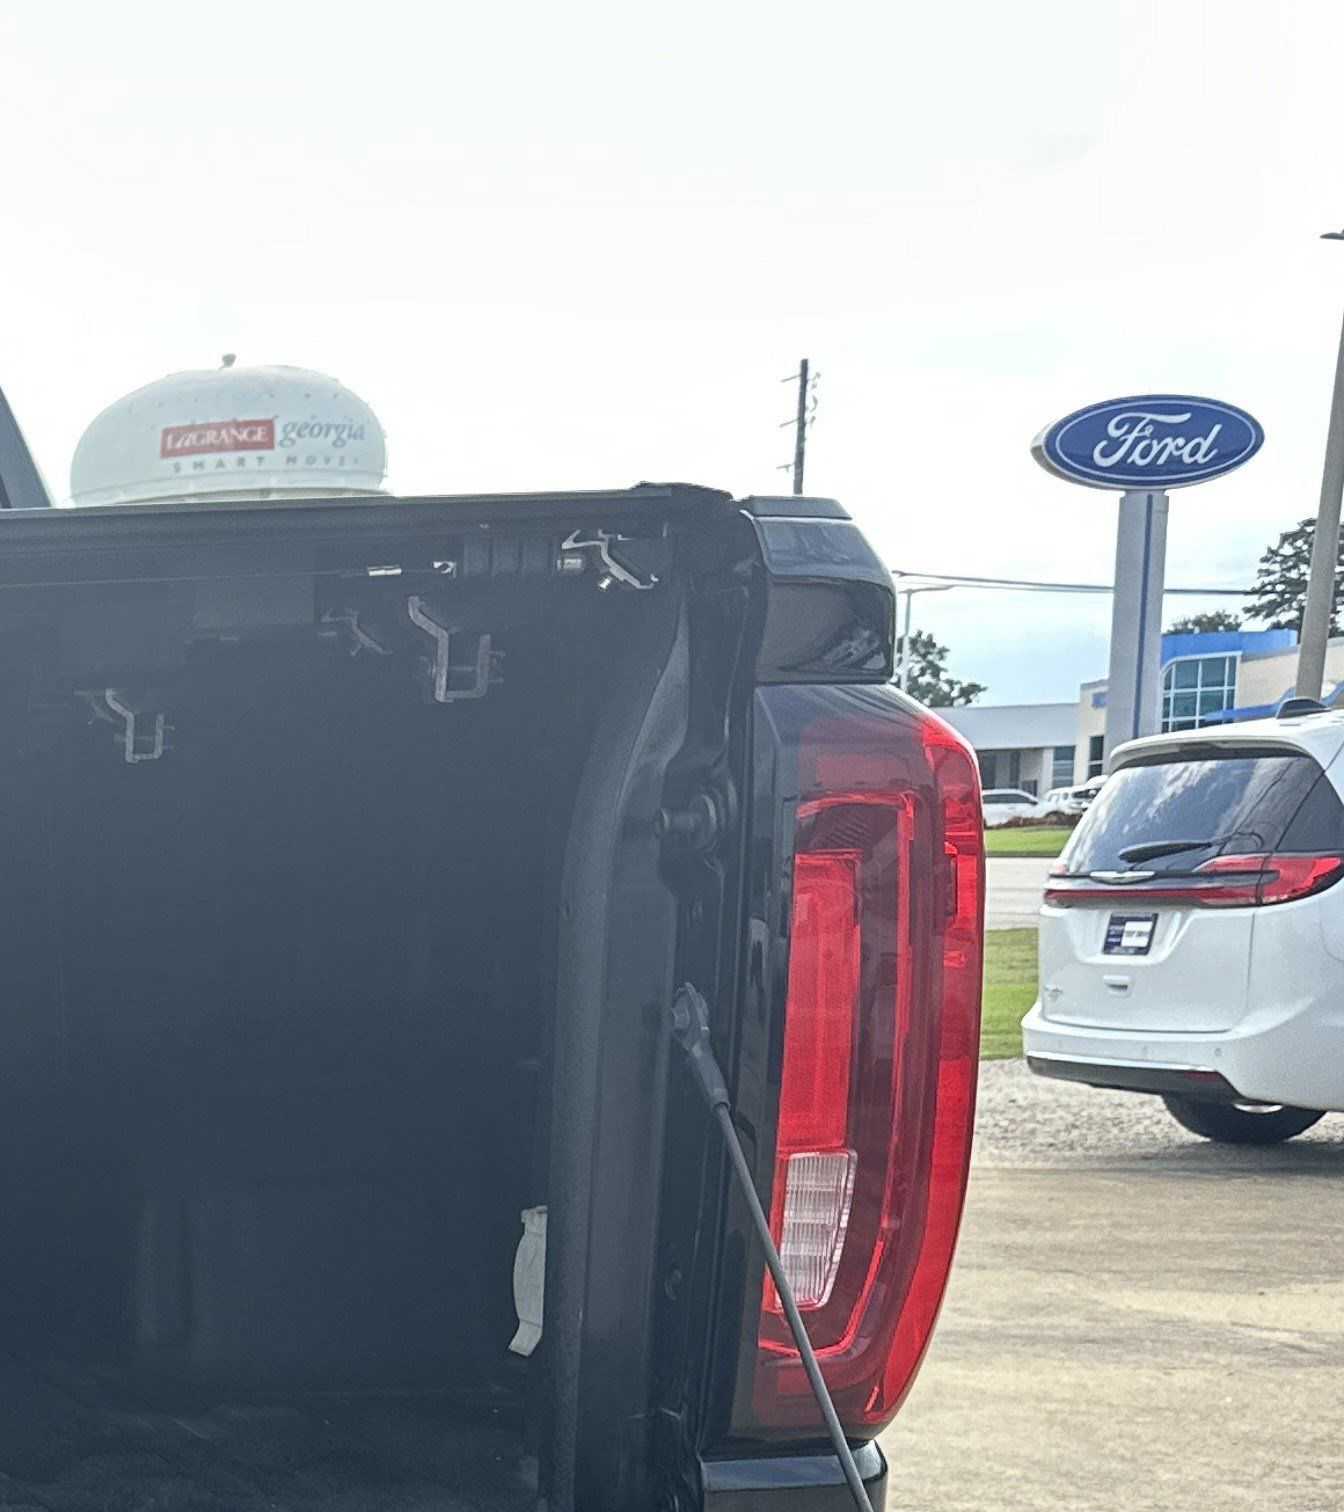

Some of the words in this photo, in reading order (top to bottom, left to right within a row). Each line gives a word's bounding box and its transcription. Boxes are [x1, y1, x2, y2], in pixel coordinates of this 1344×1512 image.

[278, 415, 366, 449] georgia
[1093, 412, 1223, 468] Ford
[172, 455, 266, 474] SMART
